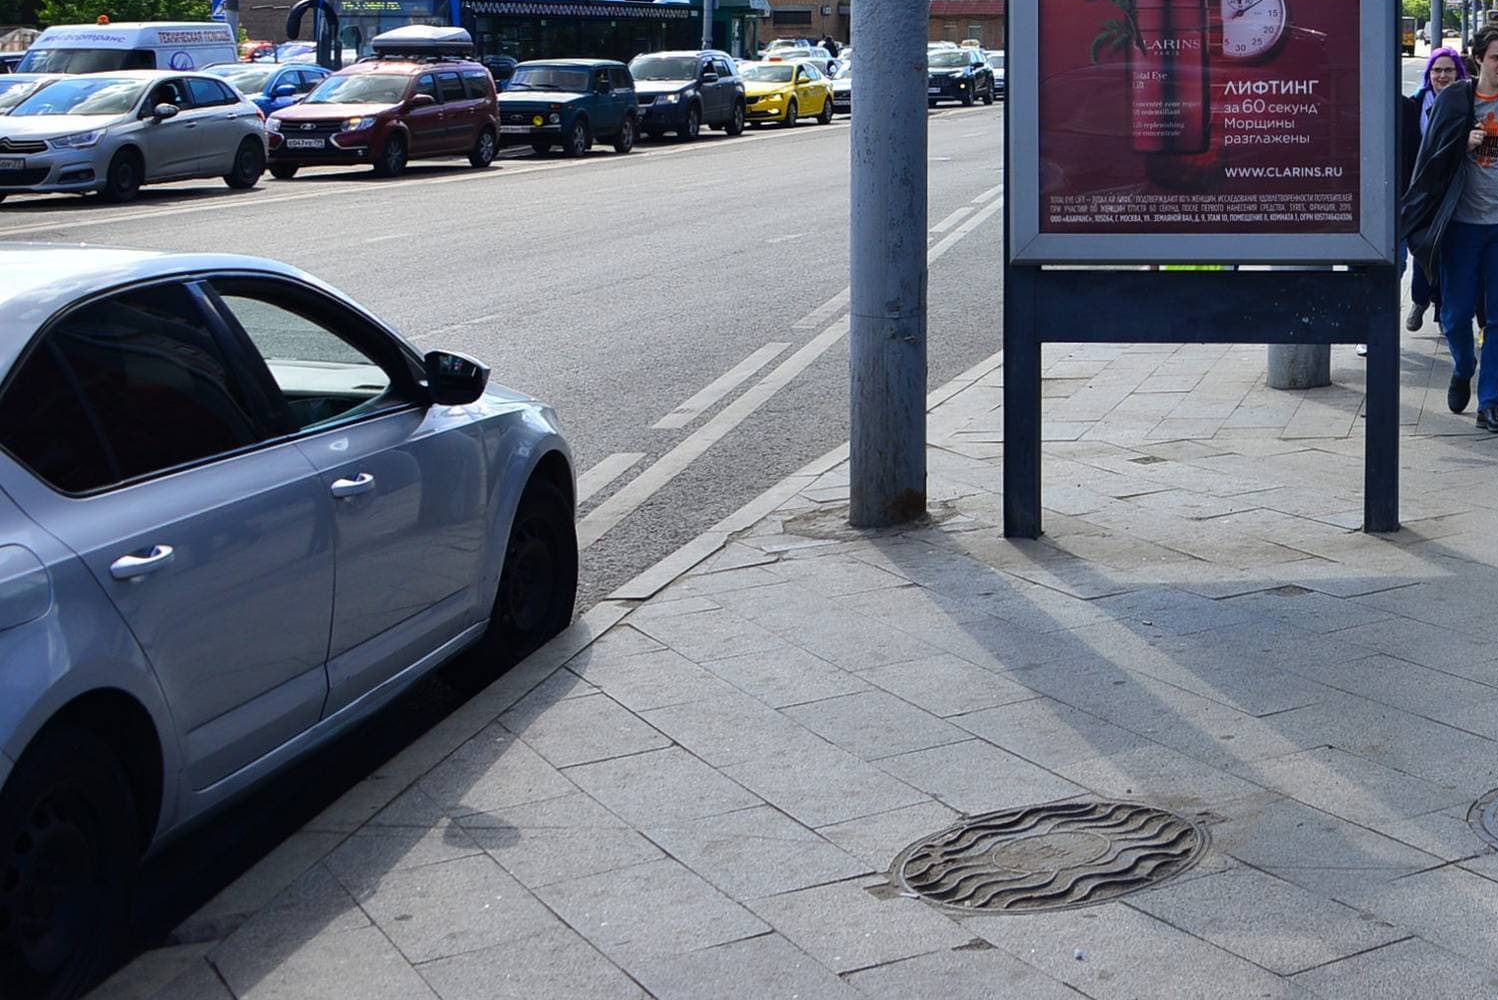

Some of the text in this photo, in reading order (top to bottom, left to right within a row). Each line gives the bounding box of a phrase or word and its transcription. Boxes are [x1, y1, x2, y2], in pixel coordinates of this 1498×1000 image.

[1224, 80, 1319, 95] ЛИФТИНГ
[1224, 104, 1240, 113] за
[1242, 98, 1265, 114] 60
[1224, 118, 1295, 130] Морщины
[1224, 134, 1310, 146] разглажены
[1225, 167, 1343, 178] WWW.CLARINS.RU
